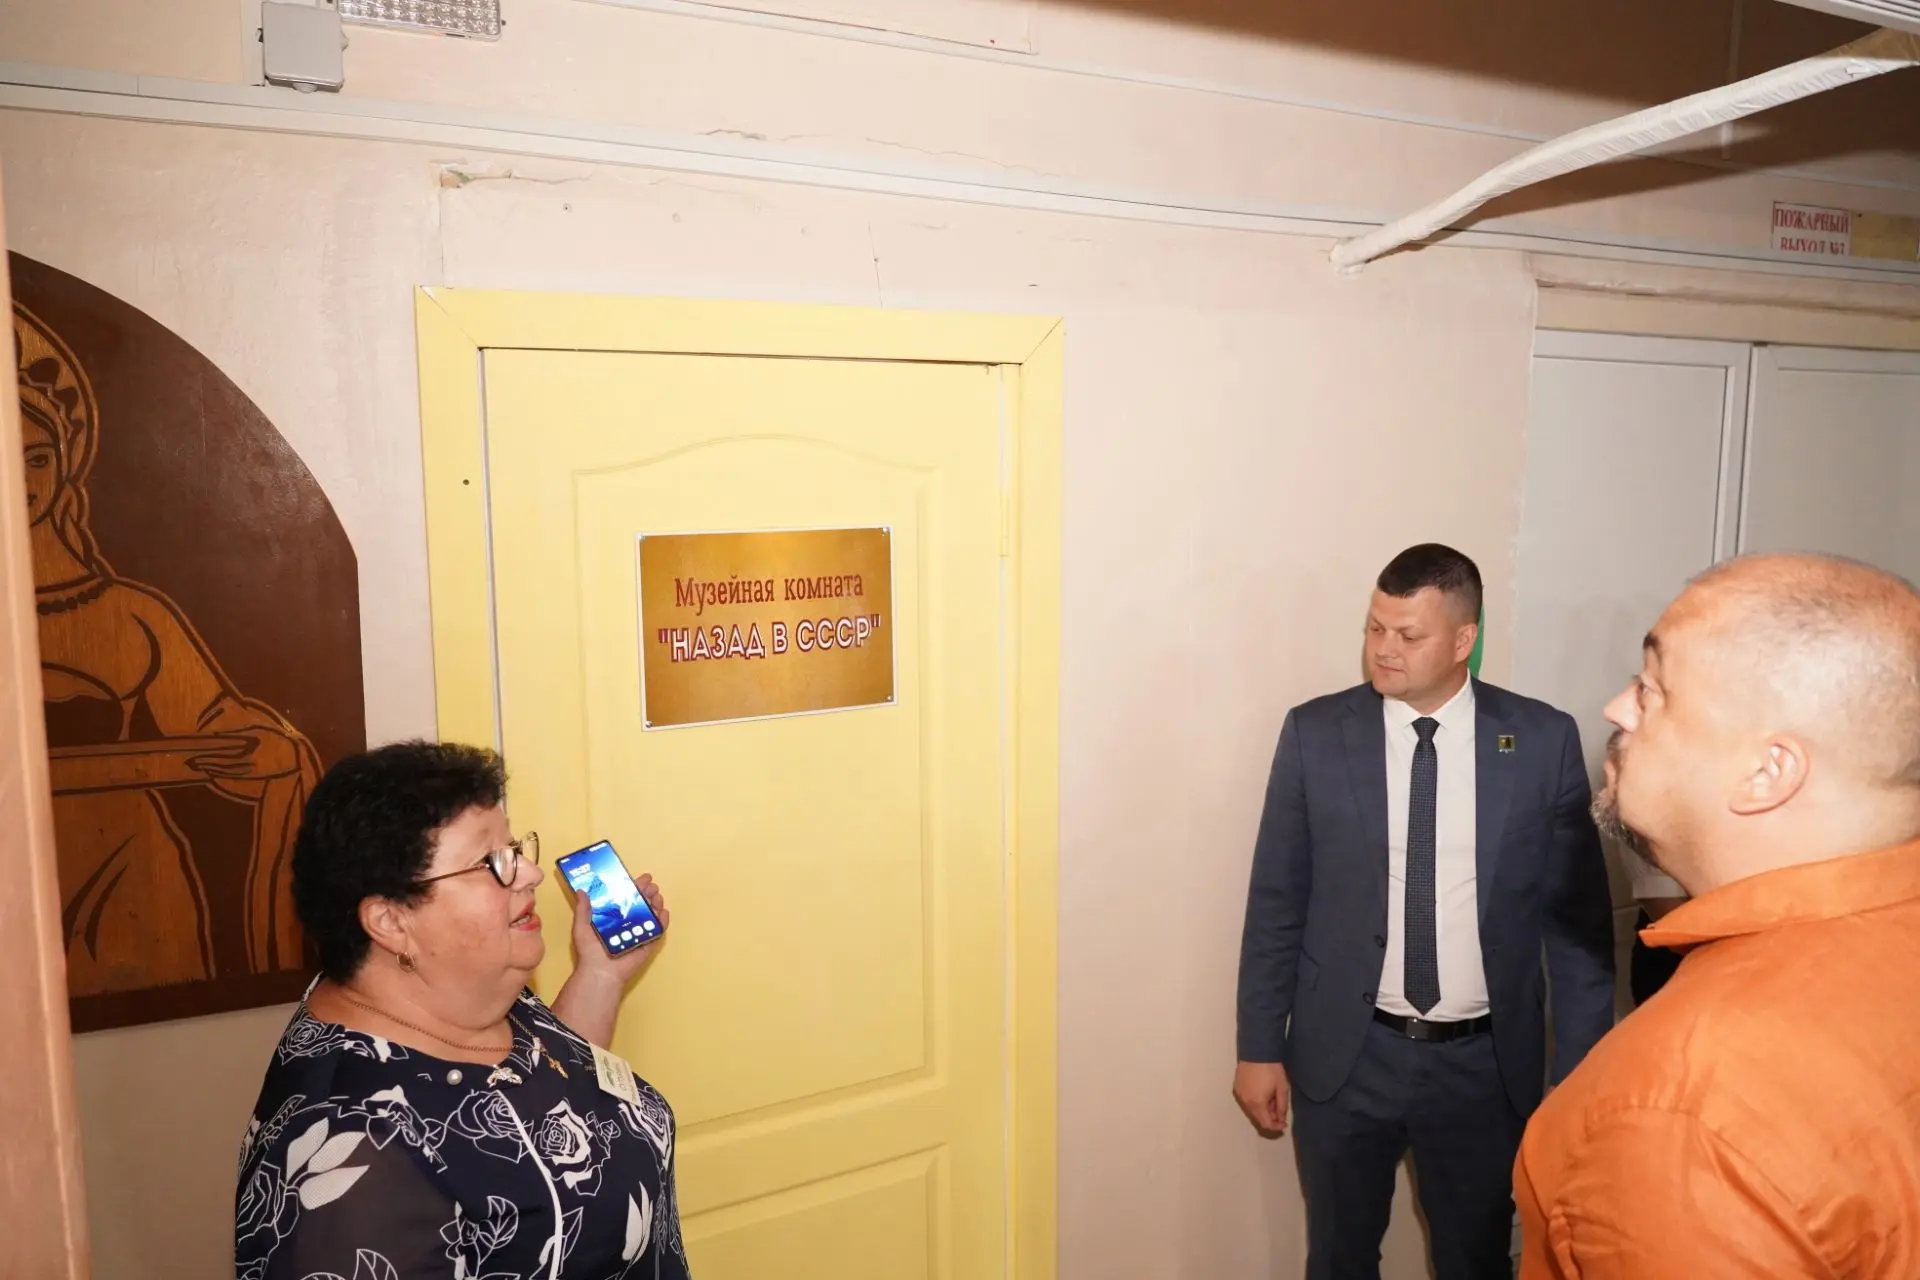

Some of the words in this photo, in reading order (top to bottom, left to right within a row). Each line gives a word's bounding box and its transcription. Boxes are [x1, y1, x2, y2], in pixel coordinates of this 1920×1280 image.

[1775, 208, 1849, 234] ПОЖАРНЫЙ
[674, 574, 775, 616] Музейная
[784, 574, 864, 601] комната
[658, 622, 766, 663] "НАЗАД
[771, 621, 788, 655] В
[795, 613, 881, 652] СССР"
